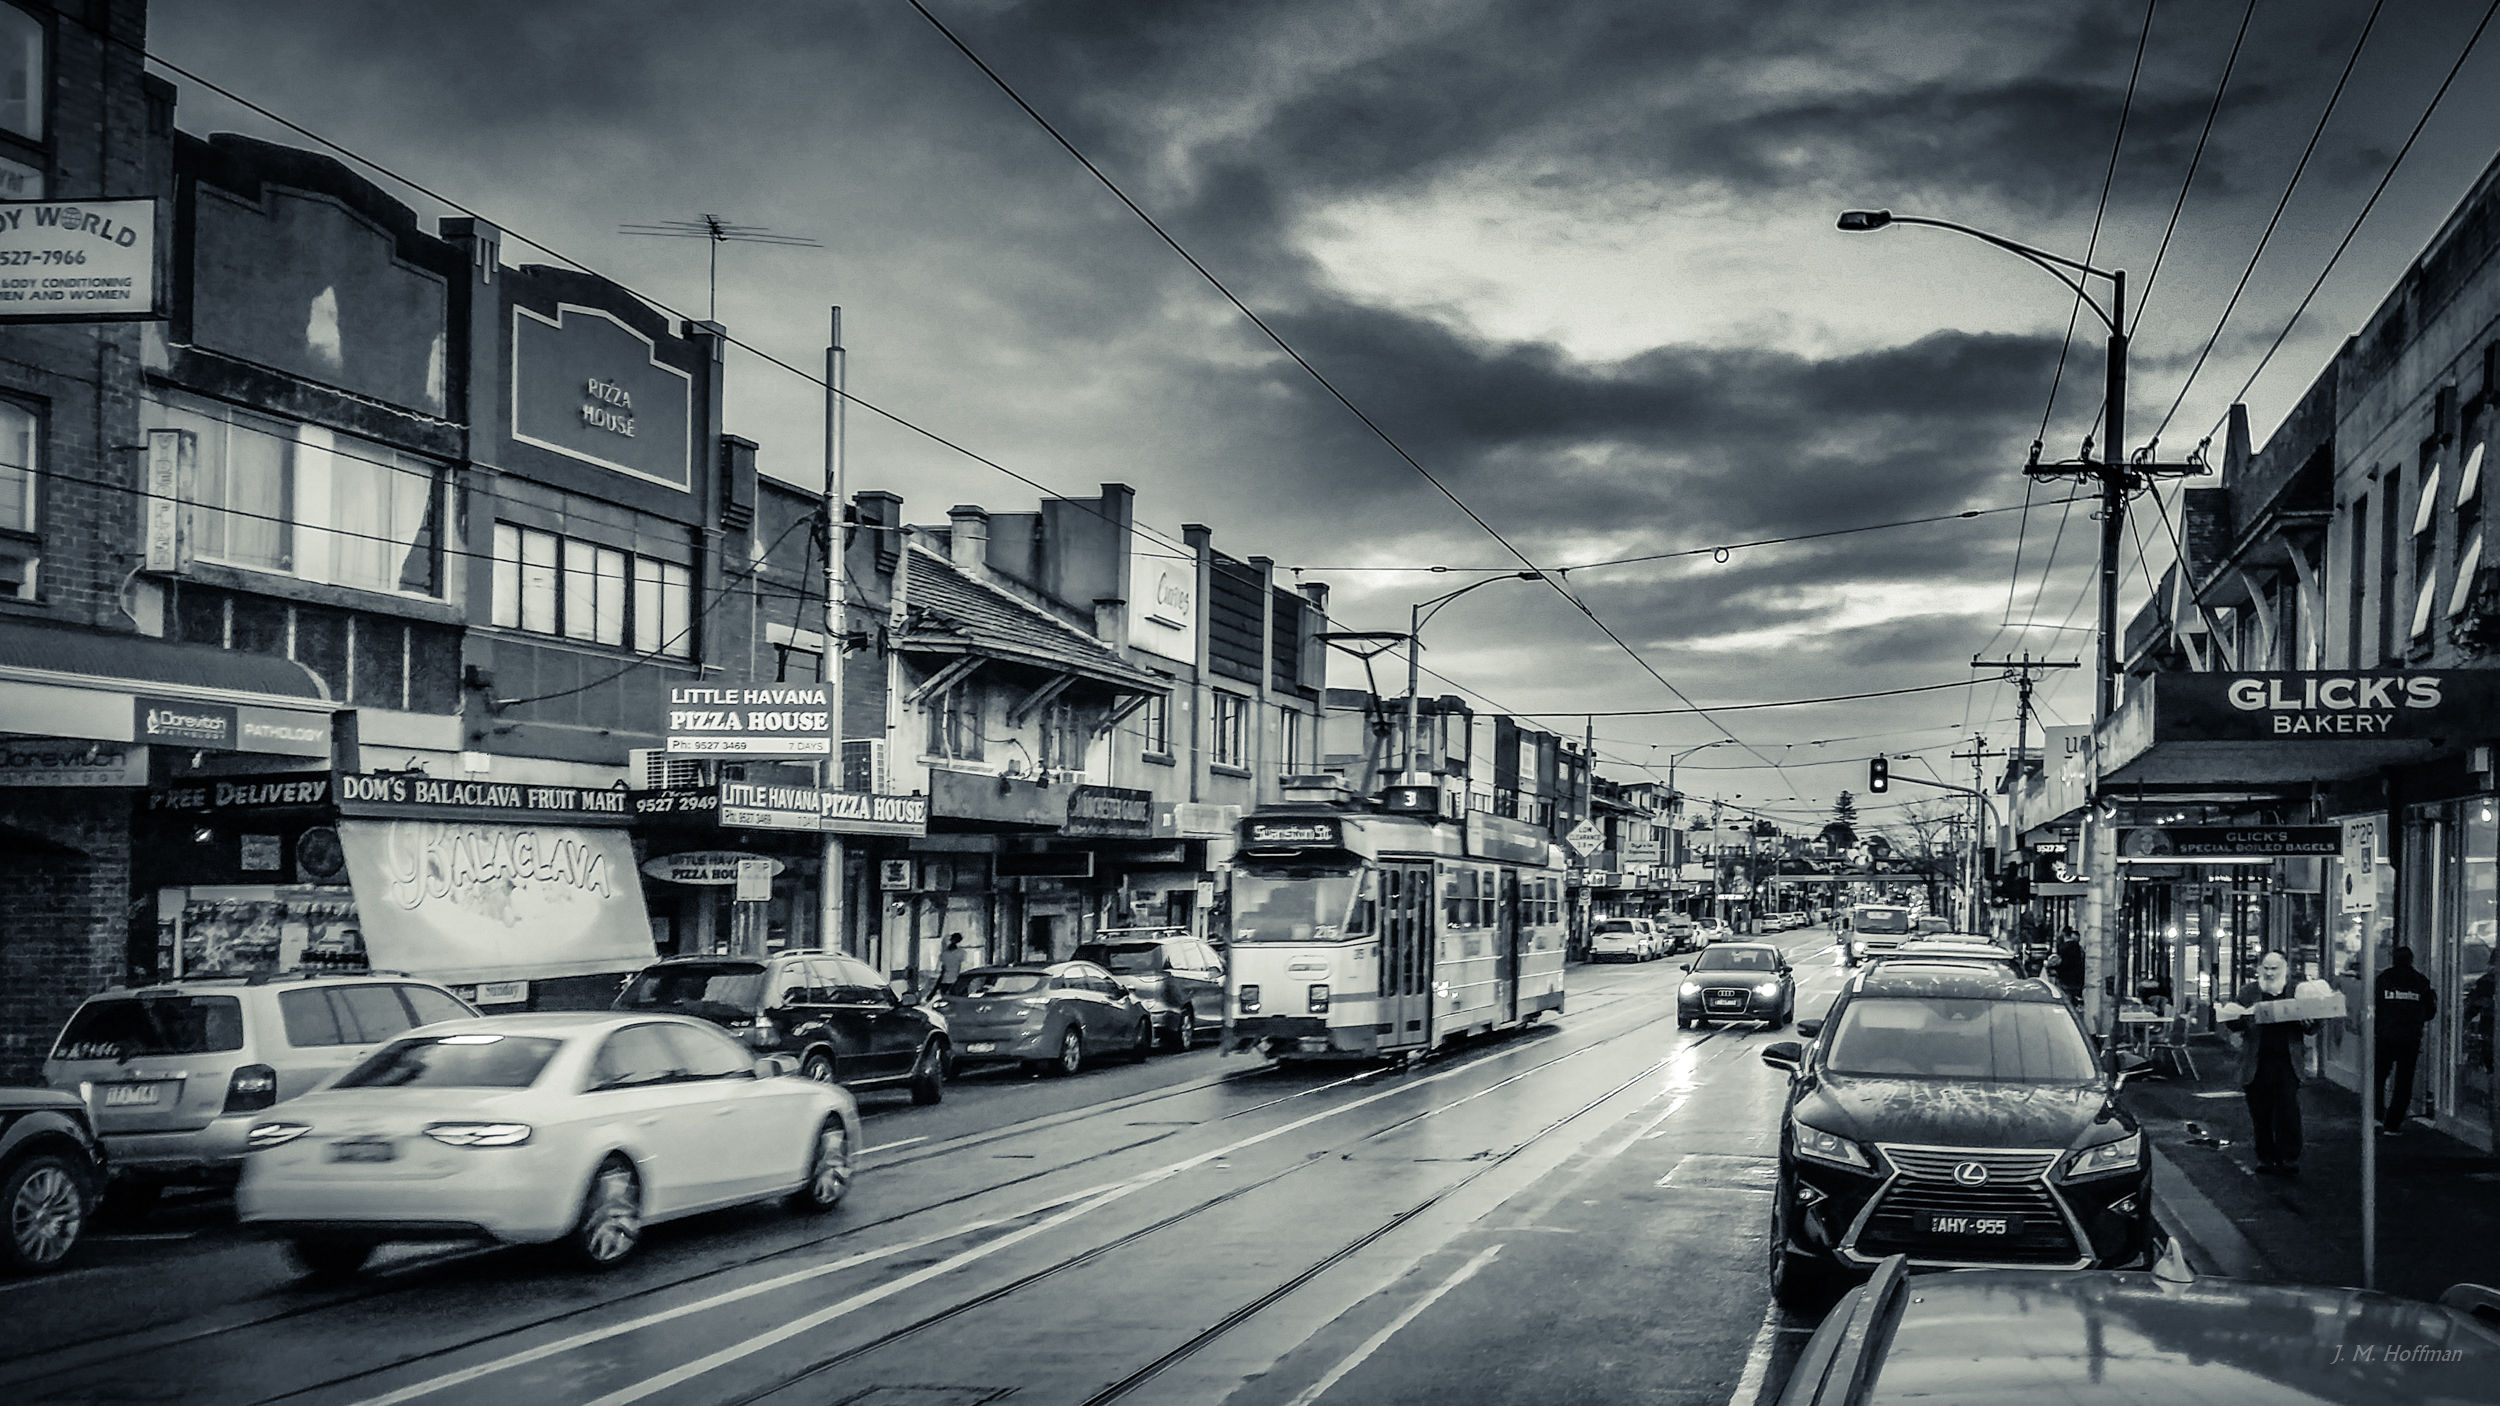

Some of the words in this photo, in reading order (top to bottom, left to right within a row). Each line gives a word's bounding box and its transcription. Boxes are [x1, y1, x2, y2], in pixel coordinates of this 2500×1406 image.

[41, 277, 132, 288] CONDITIONING
[29, 291, 64, 300] AND
[70, 289, 130, 300] WOMEN
[588, 378, 632, 408] PIZZA
[582, 403, 636, 438] HOUSE
[671, 687, 739, 705] LITTLE
[743, 688, 827, 705] HAVANA
[2228, 677, 2442, 710] GLICK'S
[669, 710, 743, 732] PIZZA
[747, 710, 829, 732] HOUSE
[2273, 714, 2393, 734] BAKERY
[244, 723, 324, 742] PATHOLOGY
[672, 740, 692, 750] Ph:
[694, 740, 721, 751] 9527
[722, 740, 747, 751] 3469
[797, 742, 824, 751] DAYS
[216, 776, 328, 806] DELIVERY
[343, 776, 406, 801] DOM'S
[415, 782, 521, 808] BALACLAVA
[528, 789, 577, 810] FRUIT
[582, 791, 627, 812] MART
[1404, 791, 1416, 807] 3
[636, 798, 674, 813] 9527
[679, 795, 718, 811] 2949
[721, 783, 767, 807] LITTLE
[768, 787, 820, 811] HAVANA
[821, 793, 871, 820] PIZZA
[873, 797, 926, 823] HOUSE
[2226, 831, 2288, 841] GLICK'S
[2179, 844, 2231, 853] SPECIAL
[2286, 843, 2335, 851] BAGELS
[389, 821, 611, 911] BALACLAVA
[672, 868, 709, 880] PIZZA
[712, 870, 739, 881] HOU
